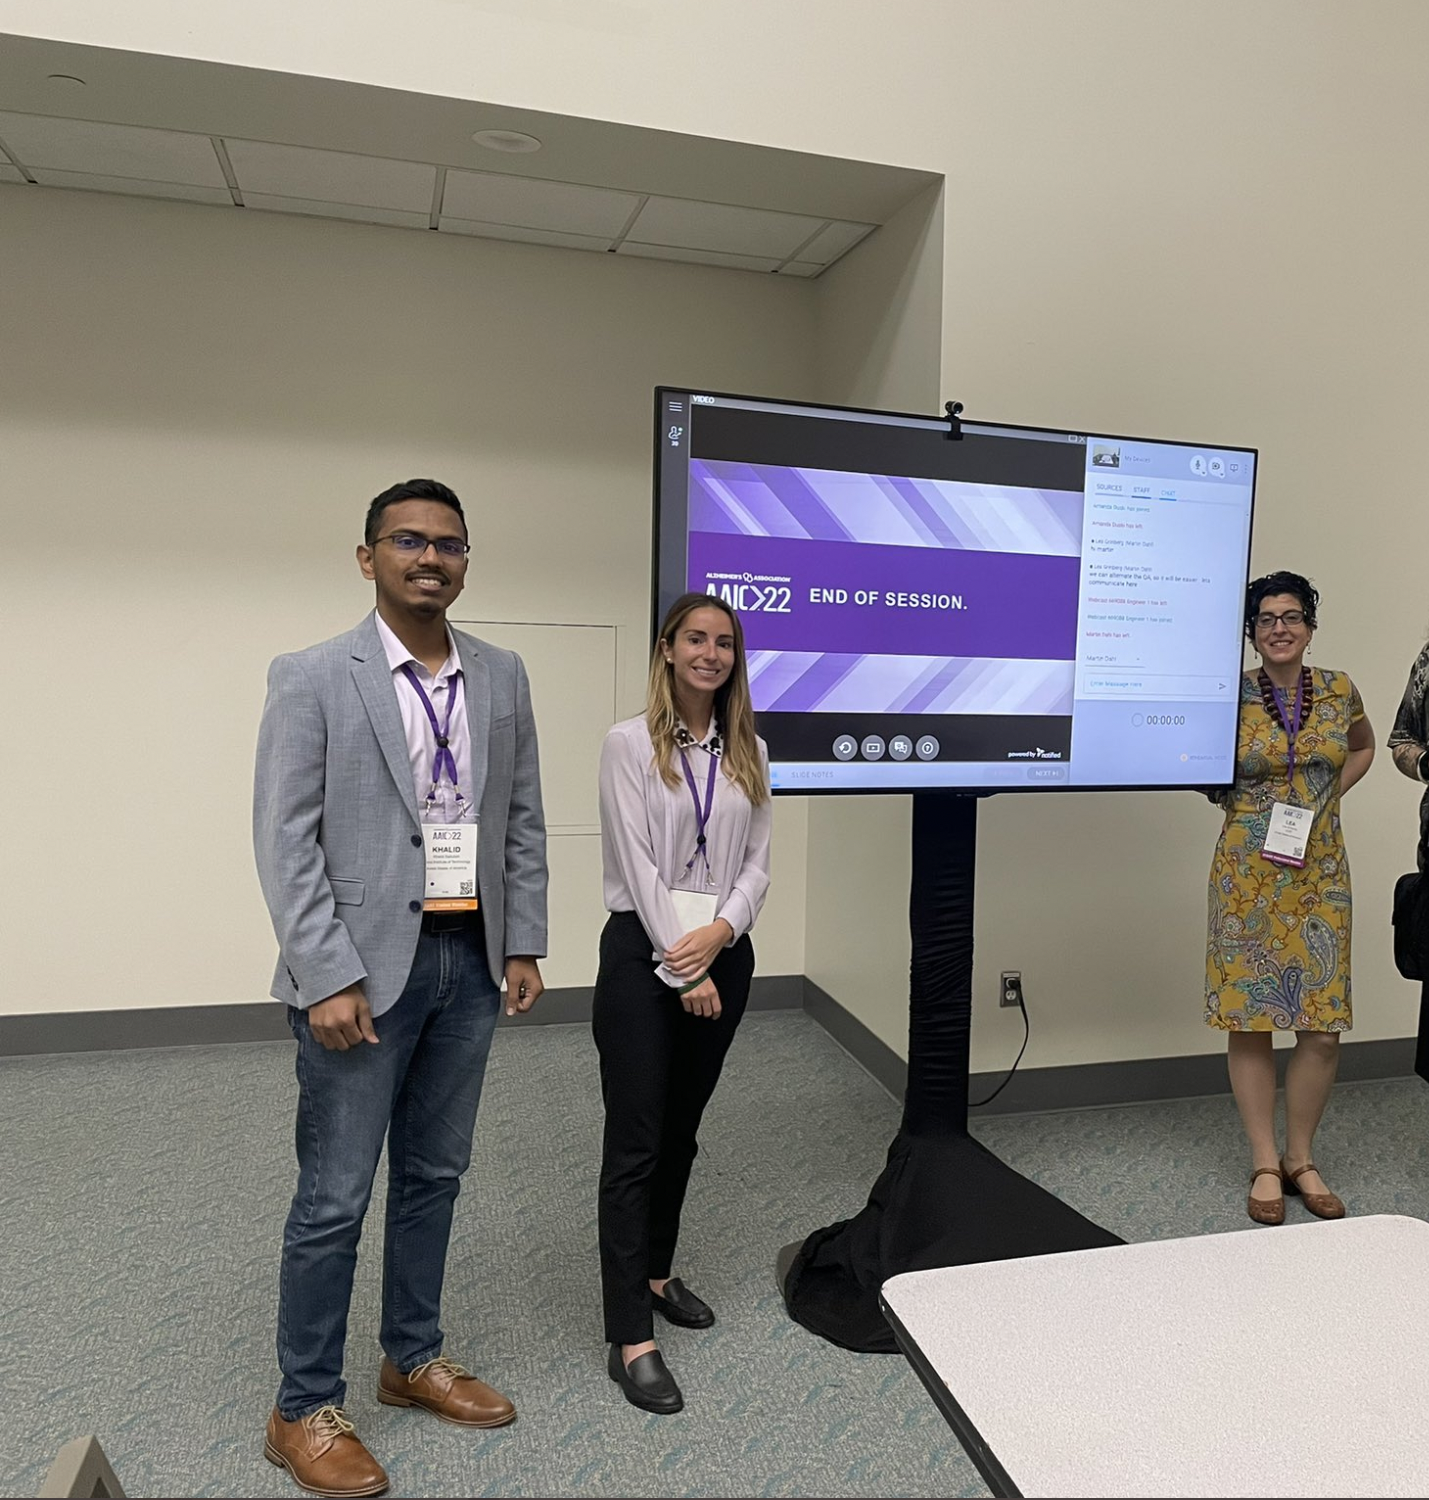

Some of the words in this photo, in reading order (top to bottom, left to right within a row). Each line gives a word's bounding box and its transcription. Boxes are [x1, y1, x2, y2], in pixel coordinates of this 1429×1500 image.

[693, 395, 715, 404] VIDEO
[1096, 483, 1122, 492] SOURCES
[810, 588, 847, 605] END
[854, 590, 879, 605] OF
[885, 592, 968, 610] SESSION.
[1147, 715, 1186, 726] 00:00:00
